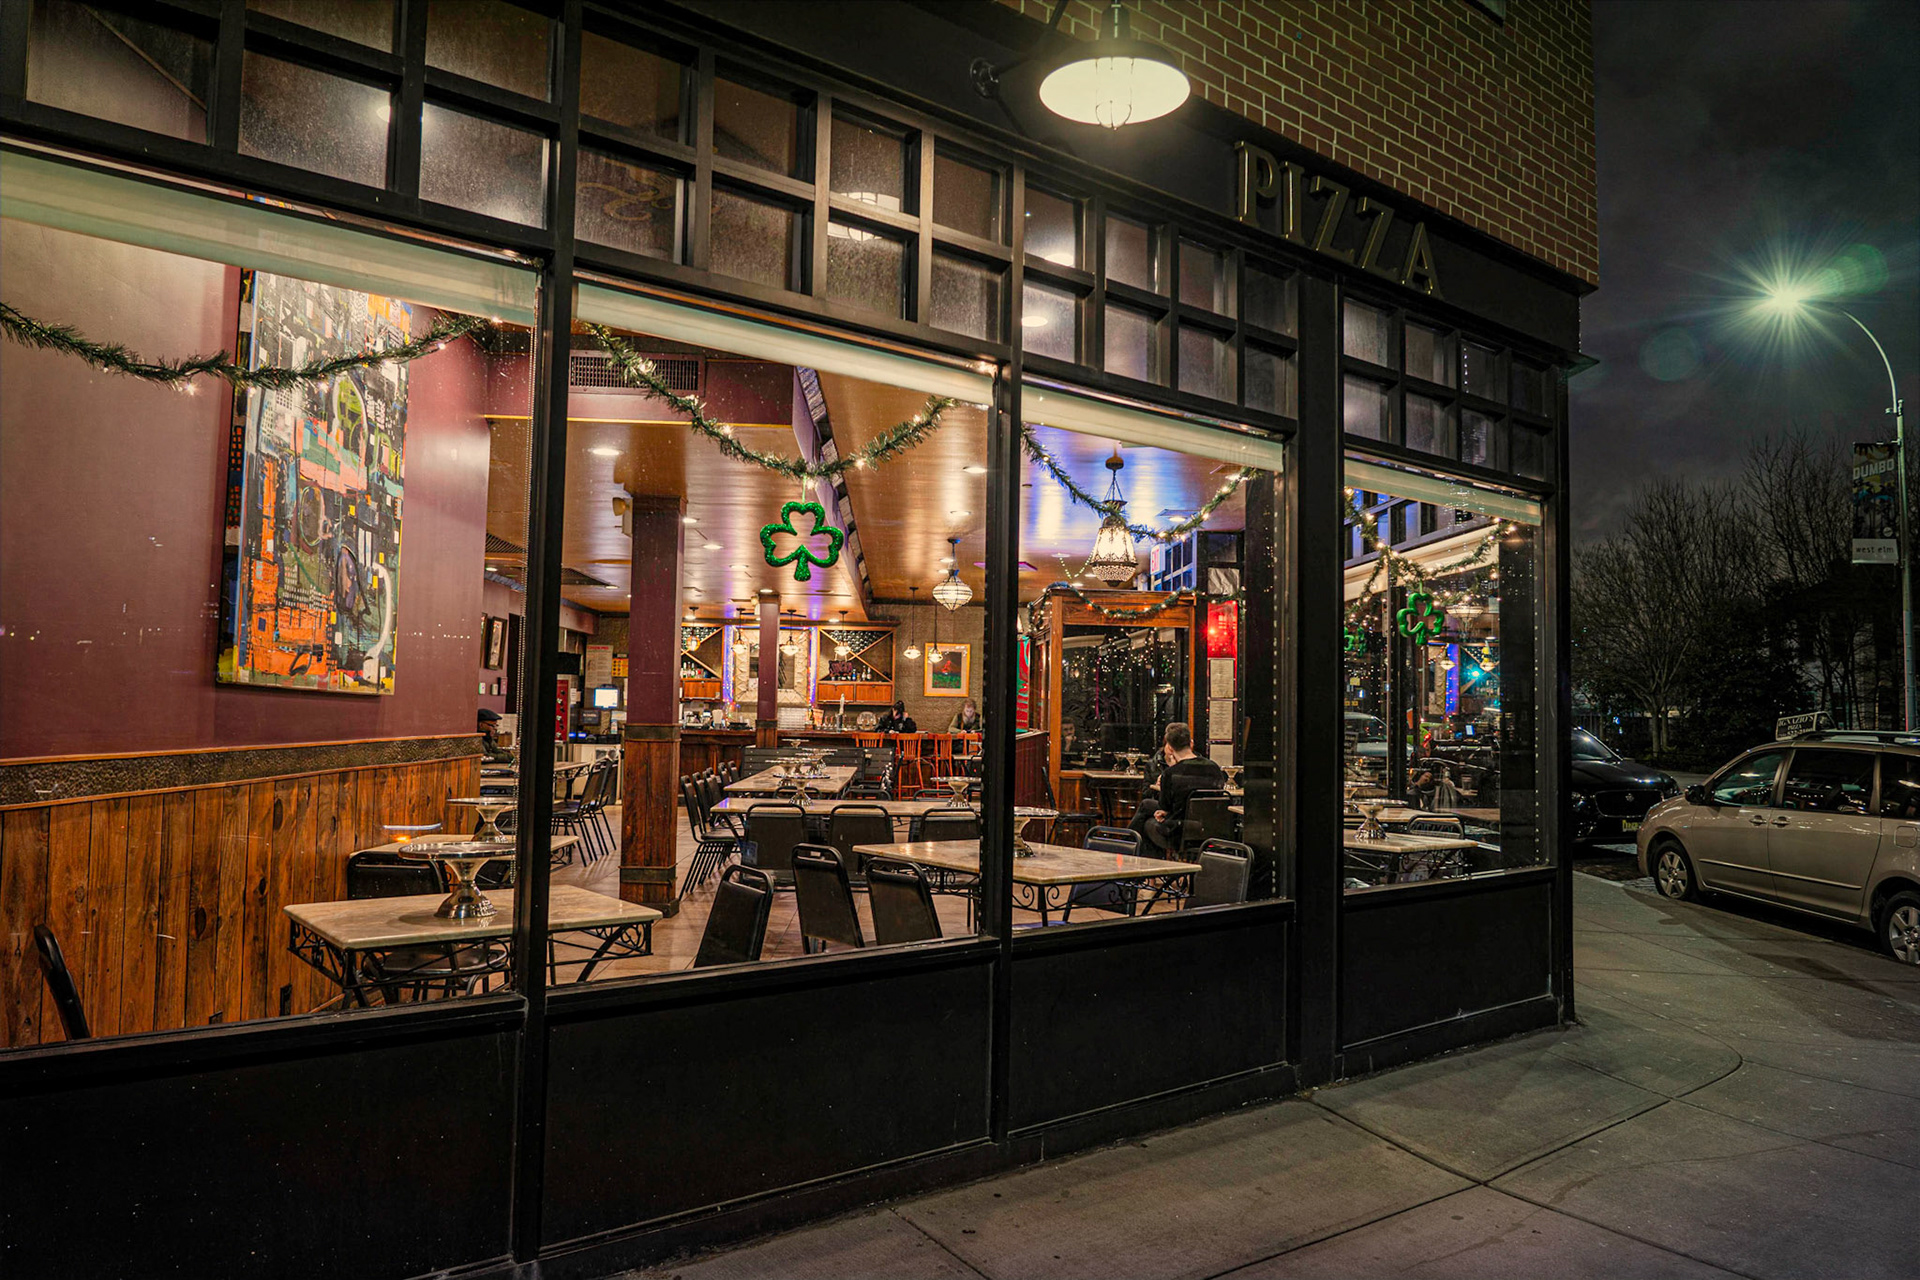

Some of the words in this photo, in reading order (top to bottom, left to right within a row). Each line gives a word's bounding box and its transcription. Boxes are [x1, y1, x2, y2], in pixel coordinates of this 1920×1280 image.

[1234, 140, 1444, 299] PIZZA
[1853, 458, 1895, 480] DUMBO
[1855, 545, 1875, 554] west
[1877, 545, 1894, 553] elm
[1787, 723, 1802, 731] PIZZA
